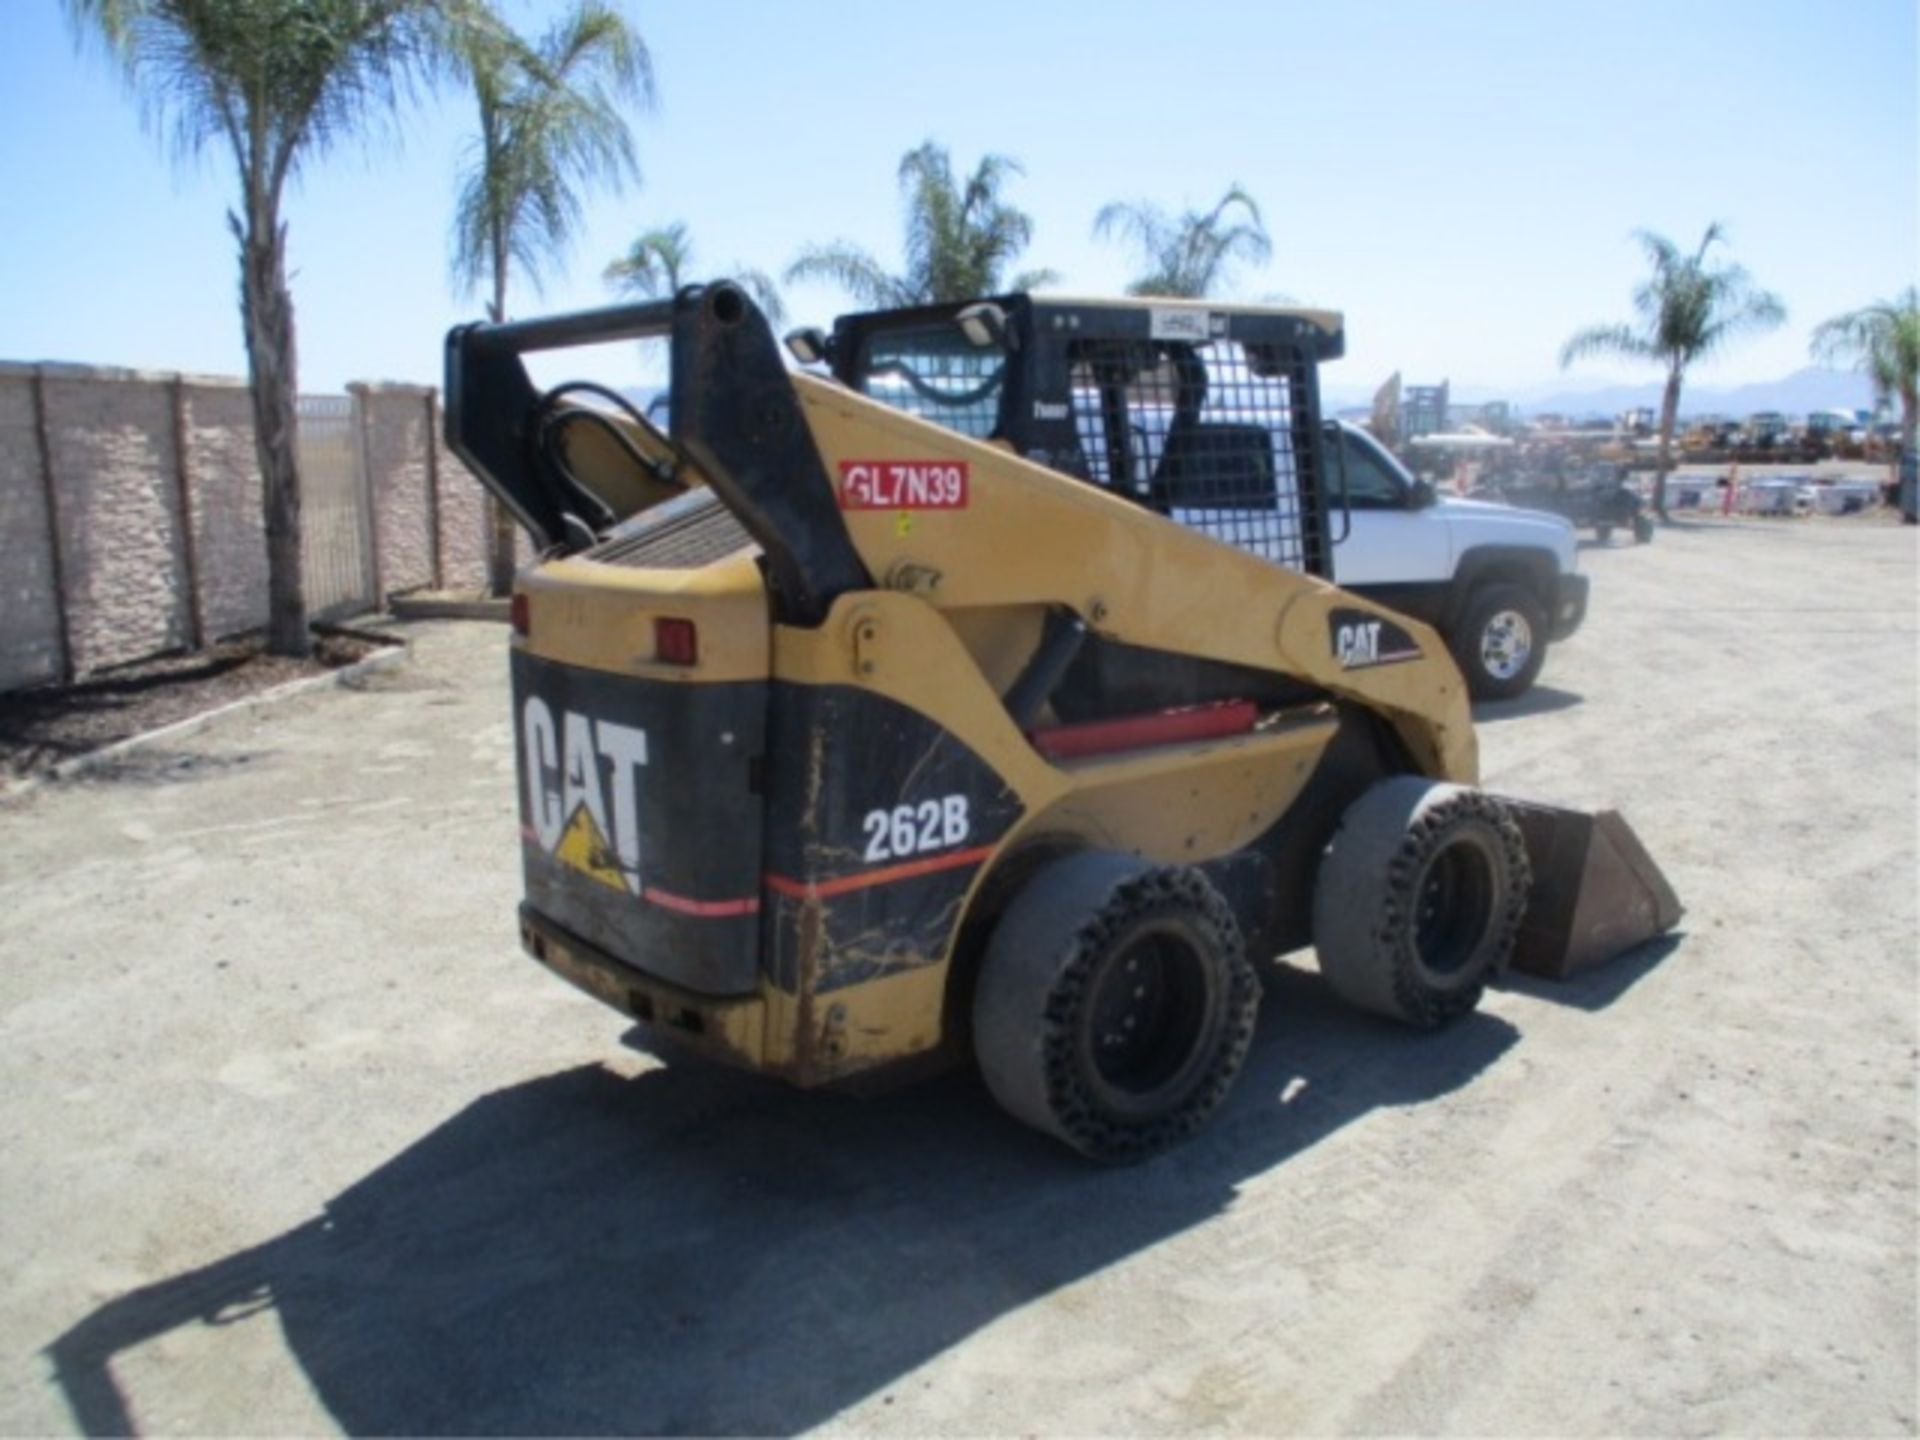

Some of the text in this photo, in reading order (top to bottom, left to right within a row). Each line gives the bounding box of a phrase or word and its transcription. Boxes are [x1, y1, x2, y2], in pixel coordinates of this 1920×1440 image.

[846, 466, 961, 505] GL7N39
[1337, 622, 1381, 666] CAT
[524, 696, 648, 897] CAT
[863, 794, 969, 863] 262B
